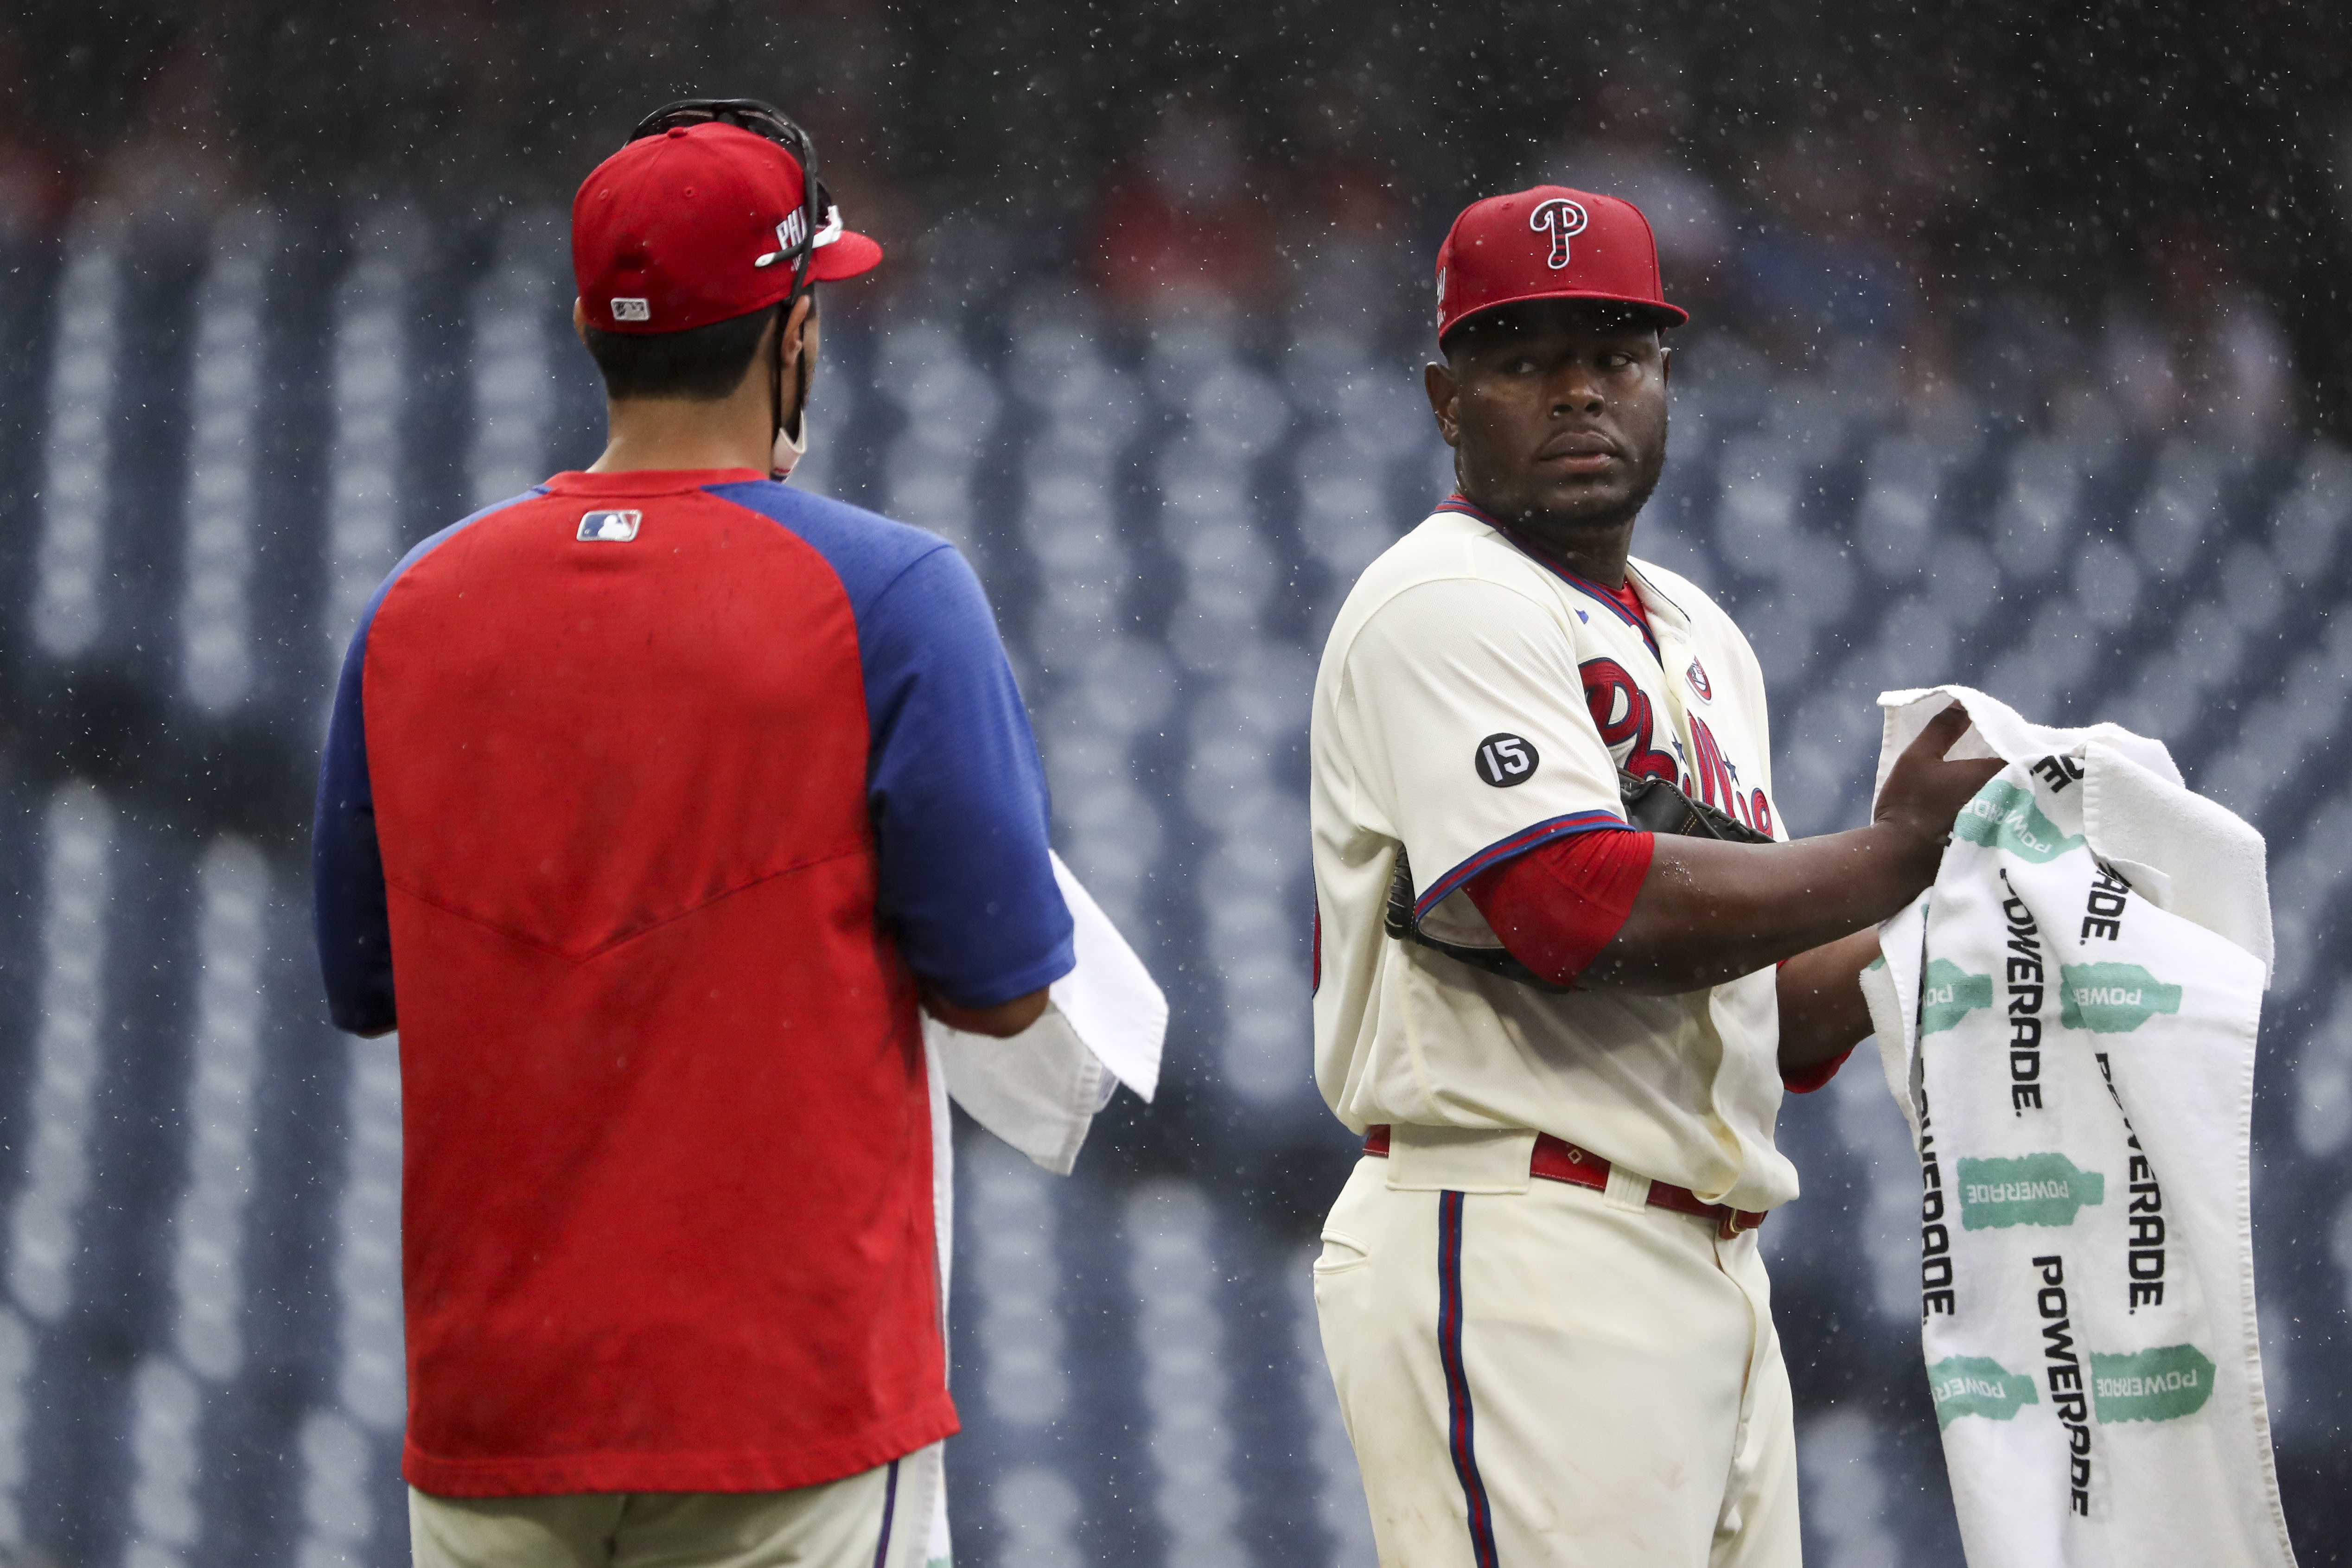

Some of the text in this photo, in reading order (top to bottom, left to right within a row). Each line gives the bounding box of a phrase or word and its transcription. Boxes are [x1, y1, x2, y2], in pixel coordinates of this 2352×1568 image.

[1483, 738, 1530, 782] 15
[1966, 1179, 2070, 1204] POWERADE
[2096, 1369, 2198, 1397] POWERADE
